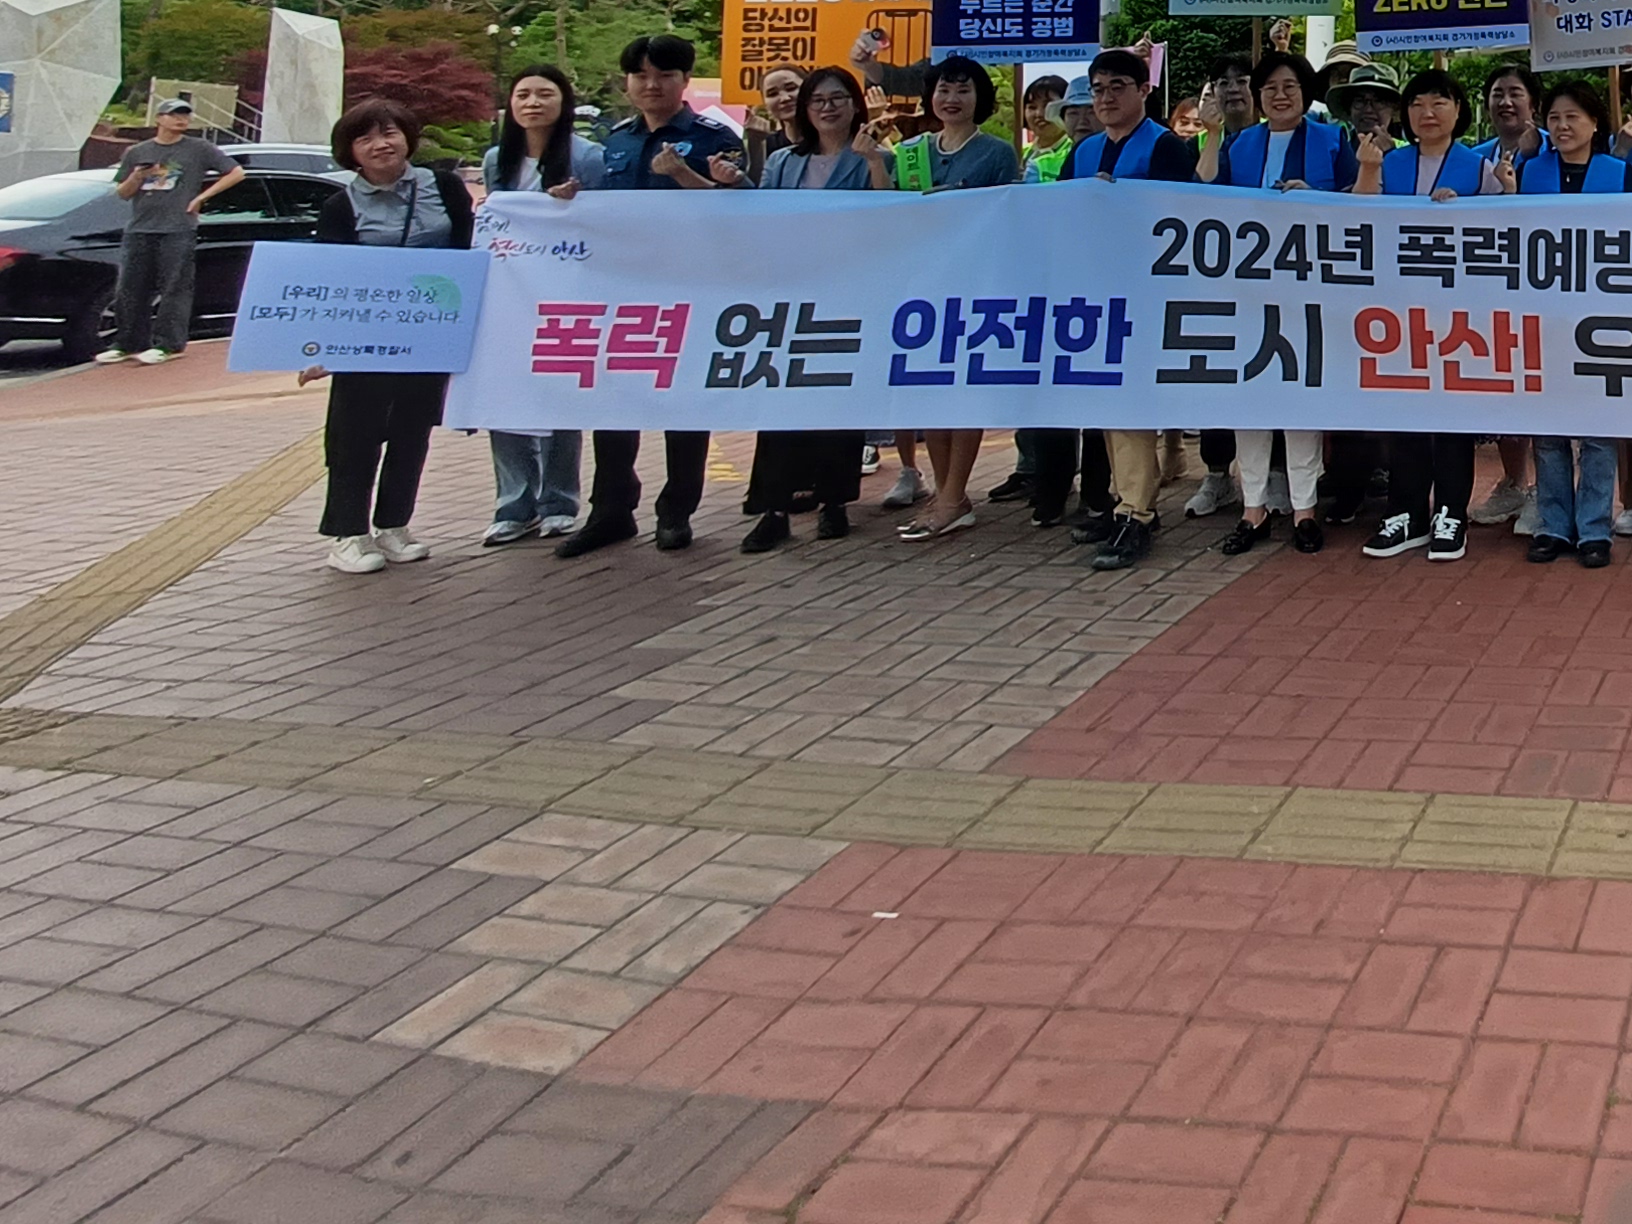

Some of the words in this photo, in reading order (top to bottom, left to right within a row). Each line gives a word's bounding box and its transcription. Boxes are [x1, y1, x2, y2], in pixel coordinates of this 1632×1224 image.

[742, 7, 818, 33] 당신의
[959, 17, 1024, 39] 당신도
[1031, 17, 1074, 38] 공범
[1556, 12, 1594, 34] 대화
[740, 36, 816, 62] 잘못이
[551, 240, 593, 262] 안산
[1150, 217, 1375, 286] 2024년
[353, 287, 402, 303] 평온한
[322, 306, 372, 323] 지켜낼
[376, 308, 392, 321] 수
[398, 308, 463, 325] 있습니다.
[531, 301, 691, 389] 폭력
[705, 301, 862, 389] 없는
[888, 297, 1132, 387] 안전한
[1155, 299, 1322, 388] 도시
[1354, 306, 1542, 393] 안산!
